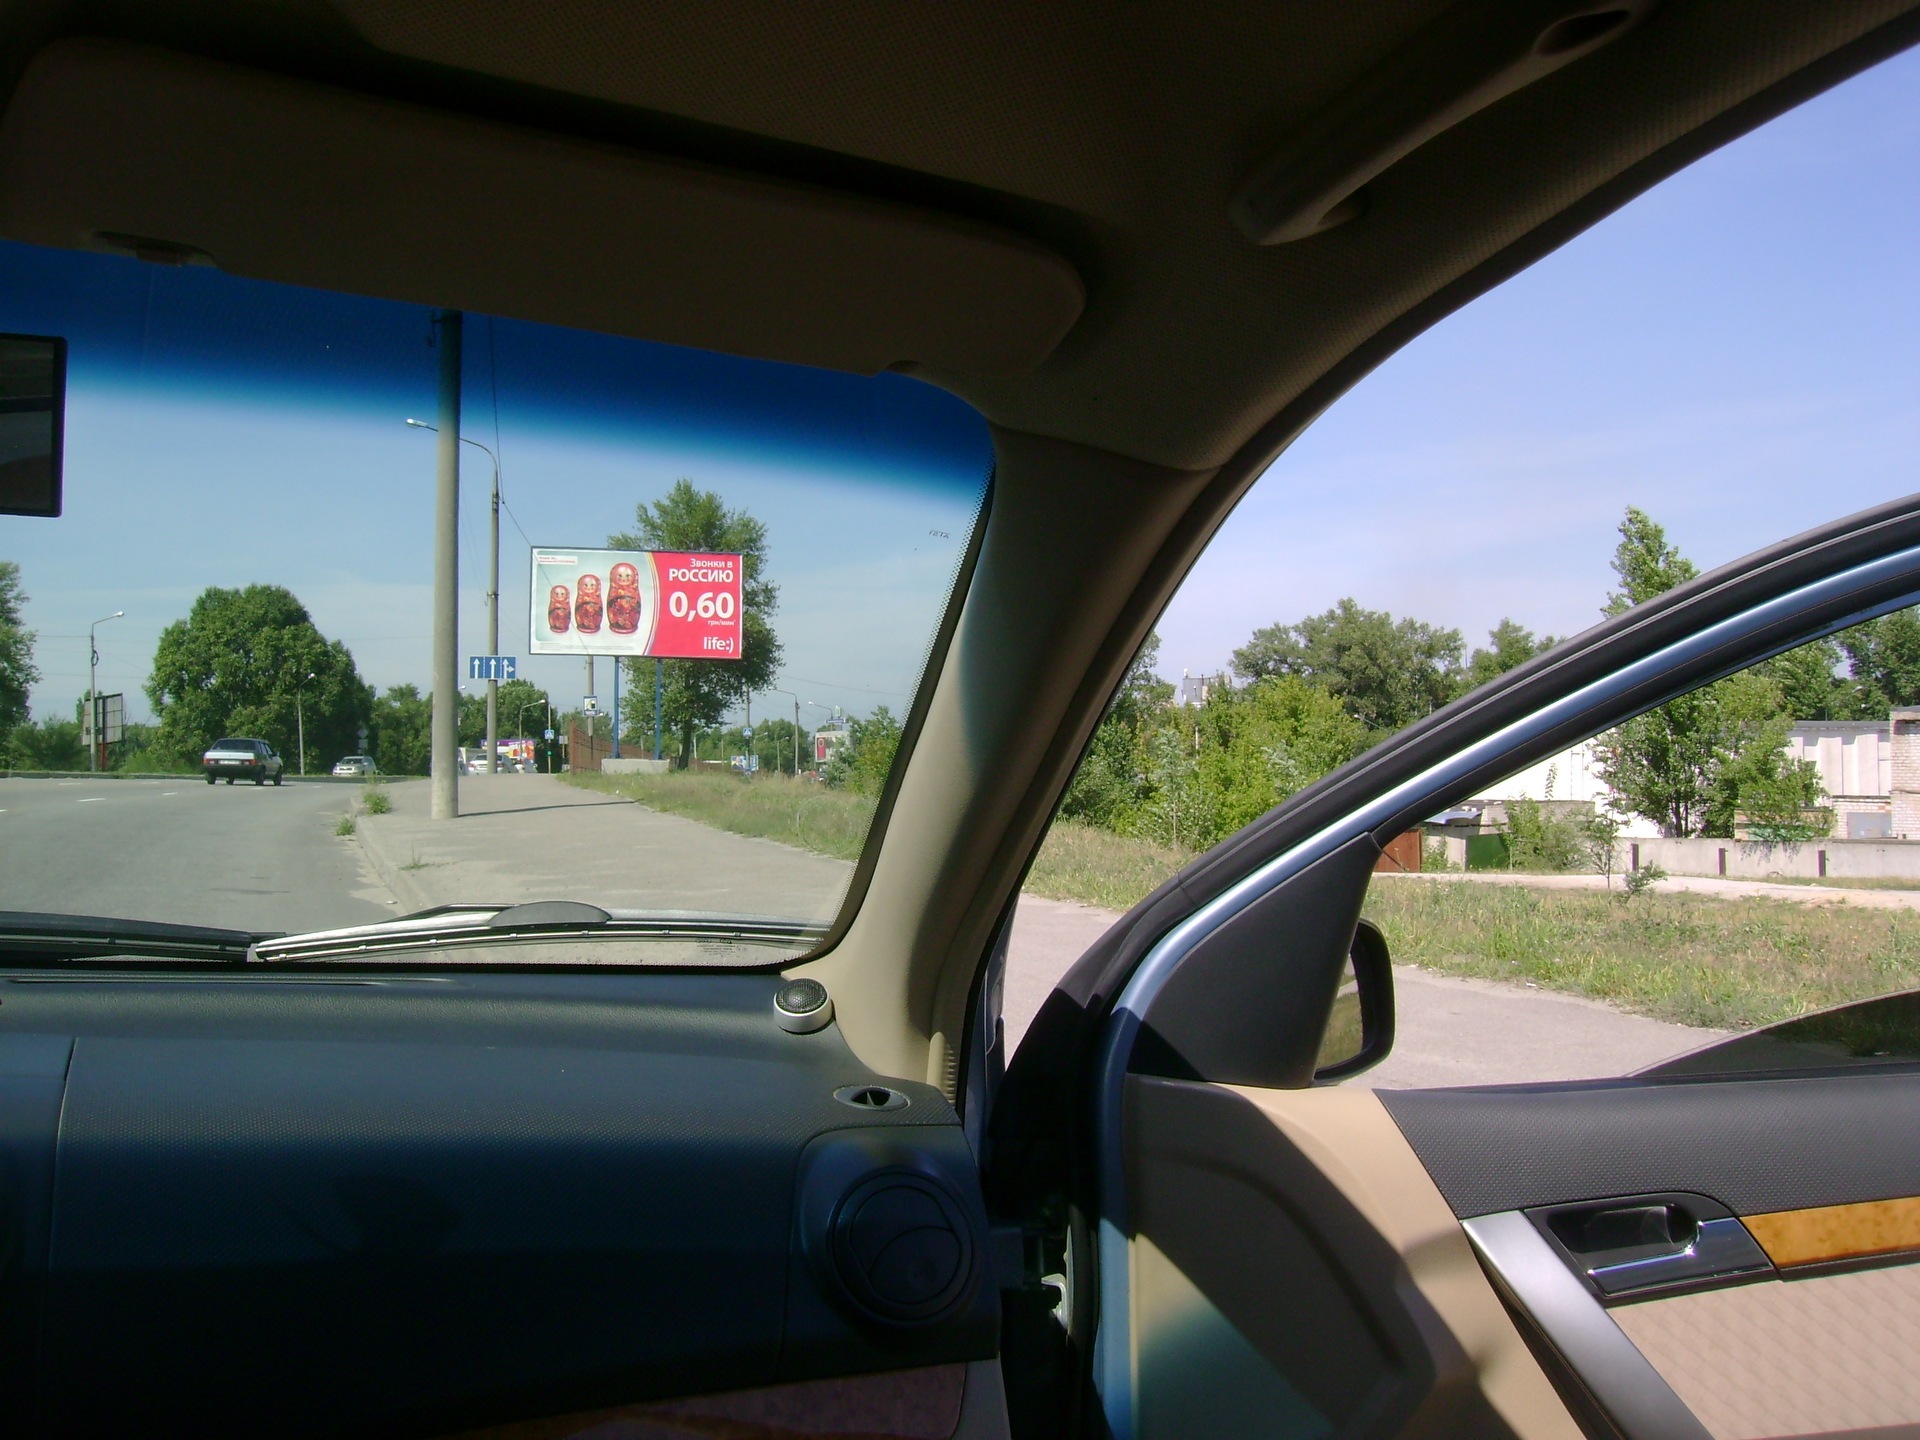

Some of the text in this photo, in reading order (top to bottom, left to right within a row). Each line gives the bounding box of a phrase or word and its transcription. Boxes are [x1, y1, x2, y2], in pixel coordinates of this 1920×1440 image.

[690, 558, 725, 568] Звонки
[669, 568, 734, 583] РОССИЮ
[669, 591, 734, 622] 0,60
[703, 636, 734, 654] life:)
